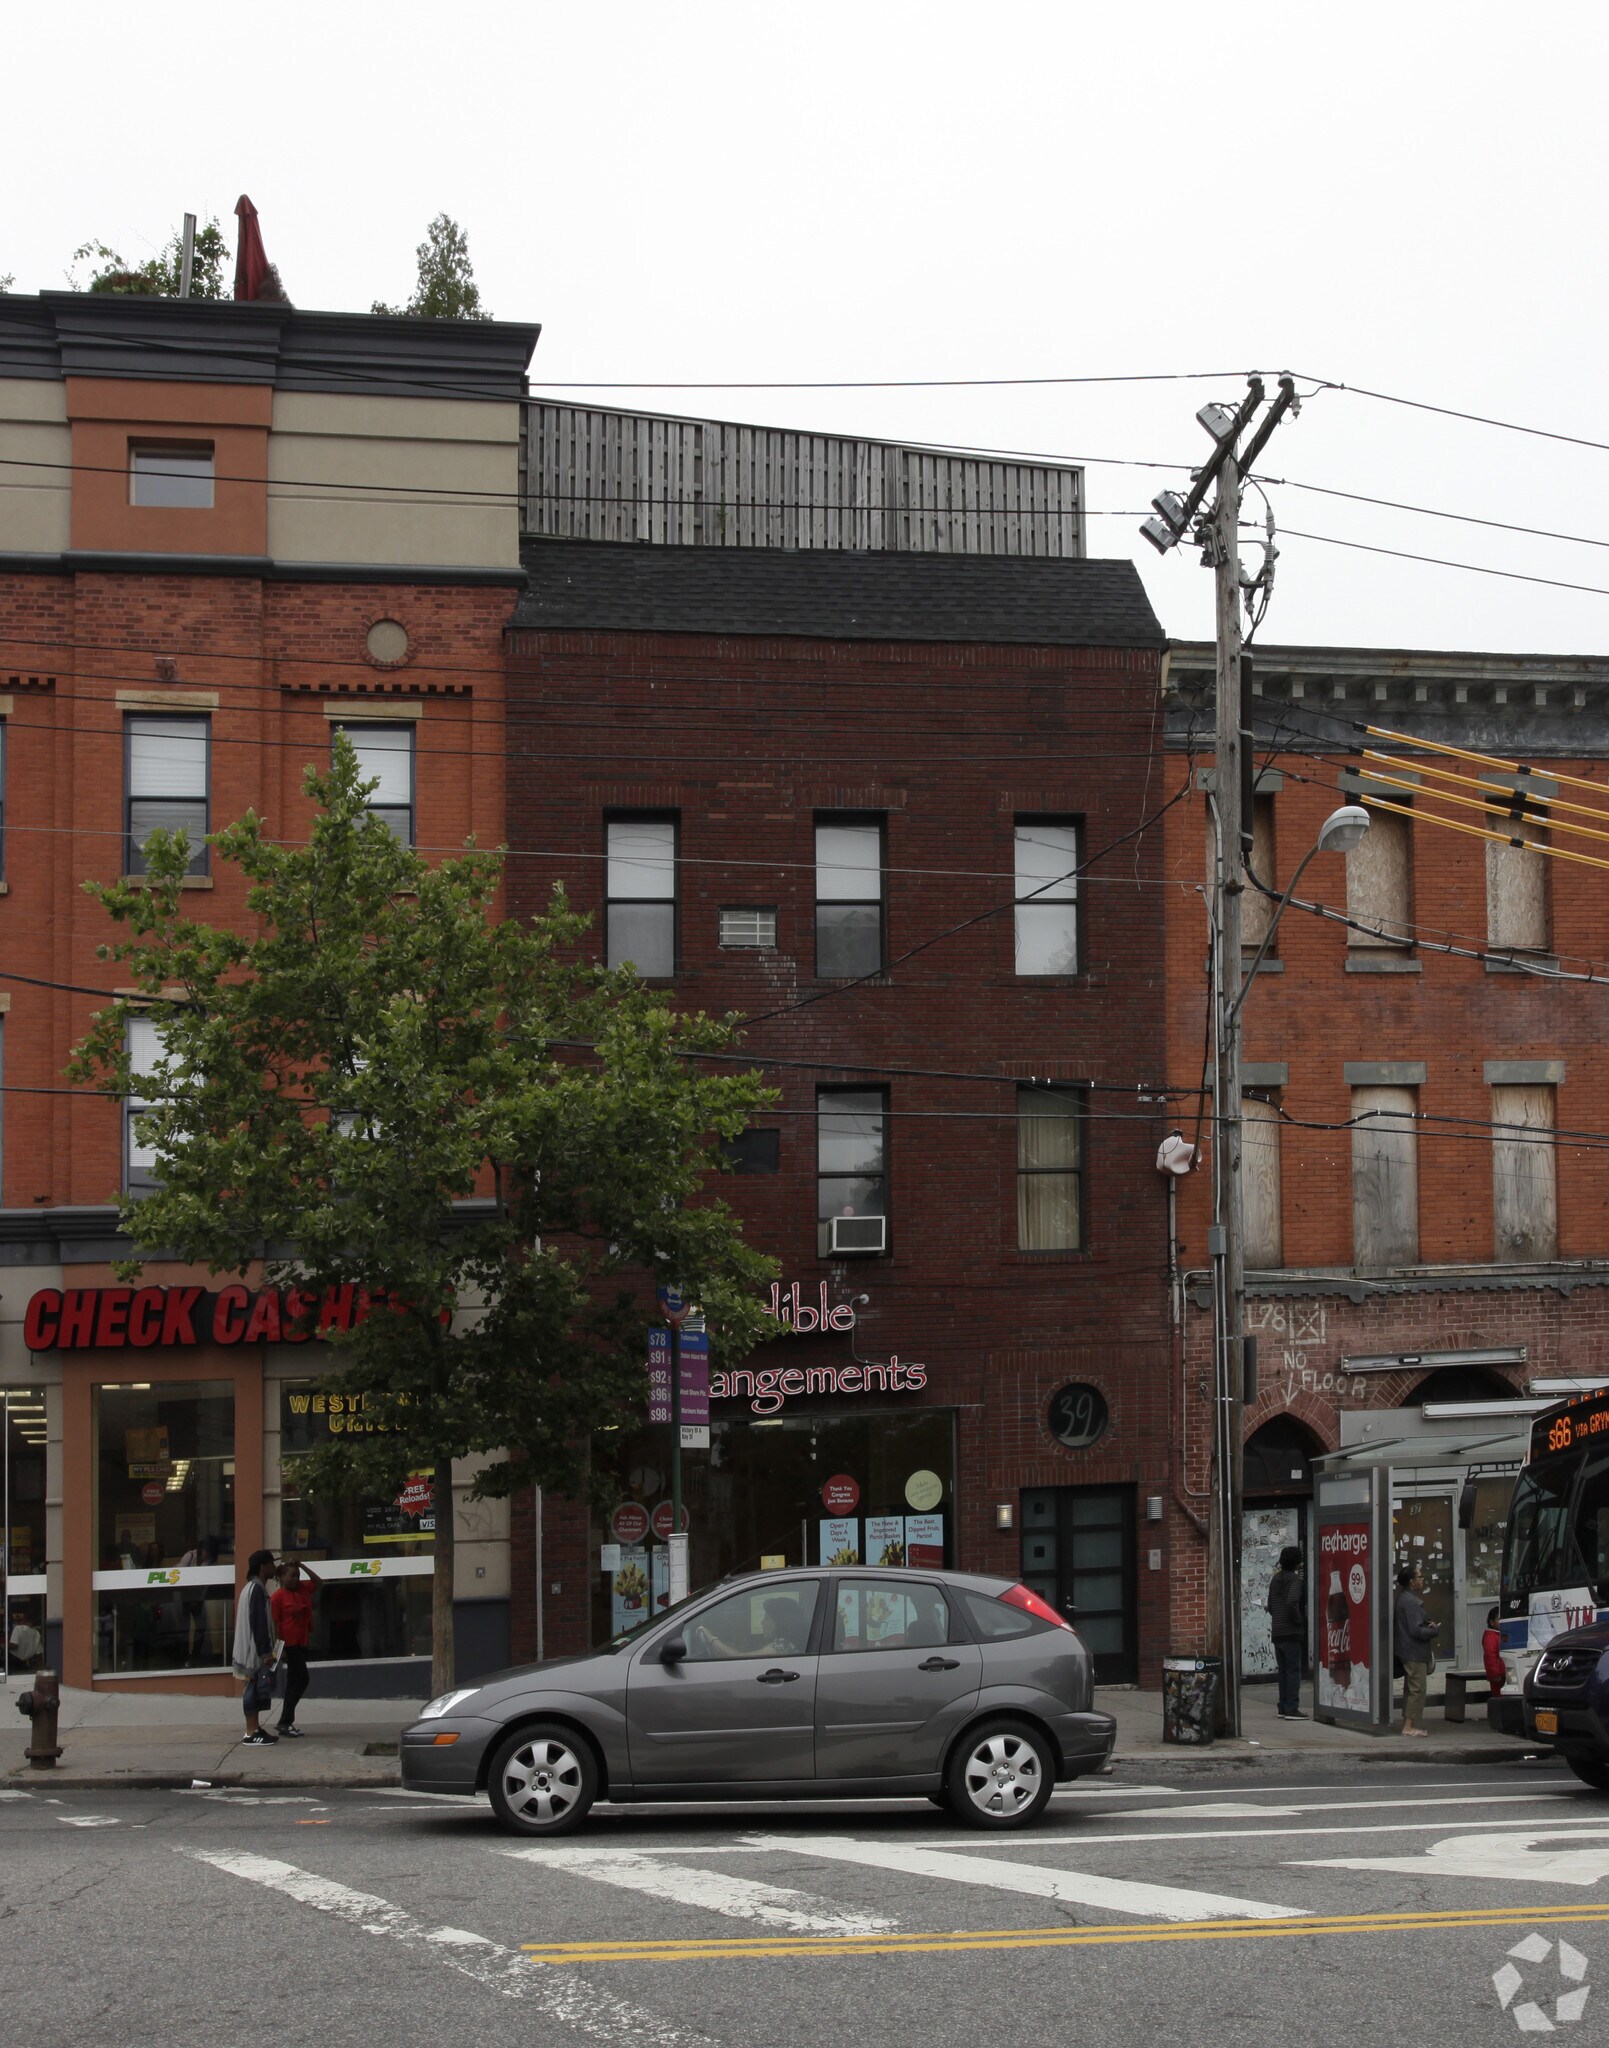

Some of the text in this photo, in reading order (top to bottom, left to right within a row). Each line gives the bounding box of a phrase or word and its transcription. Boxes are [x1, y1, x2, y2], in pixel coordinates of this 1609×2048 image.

[761, 1281, 855, 1333] dible
[25, 1287, 203, 1351] CHECK
[649, 1333, 666, 1346] S78
[650, 1351, 665, 1364] S91
[1284, 1350, 1307, 1370] NO
[650, 1370, 666, 1384] S92
[709, 1355, 927, 1414] angements
[1302, 1370, 1367, 1399] FLOOR
[650, 1388, 667, 1401] S96
[650, 1408, 667, 1421] S98
[1060, 1393, 1093, 1438] 39
[1548, 1416, 1572, 1451] S66
[1575, 1422, 1589, 1438] VIA
[403, 1485, 425, 1496] FREE
[399, 1492, 430, 1504] Reloads!
[421, 1520, 435, 1528] VIS
